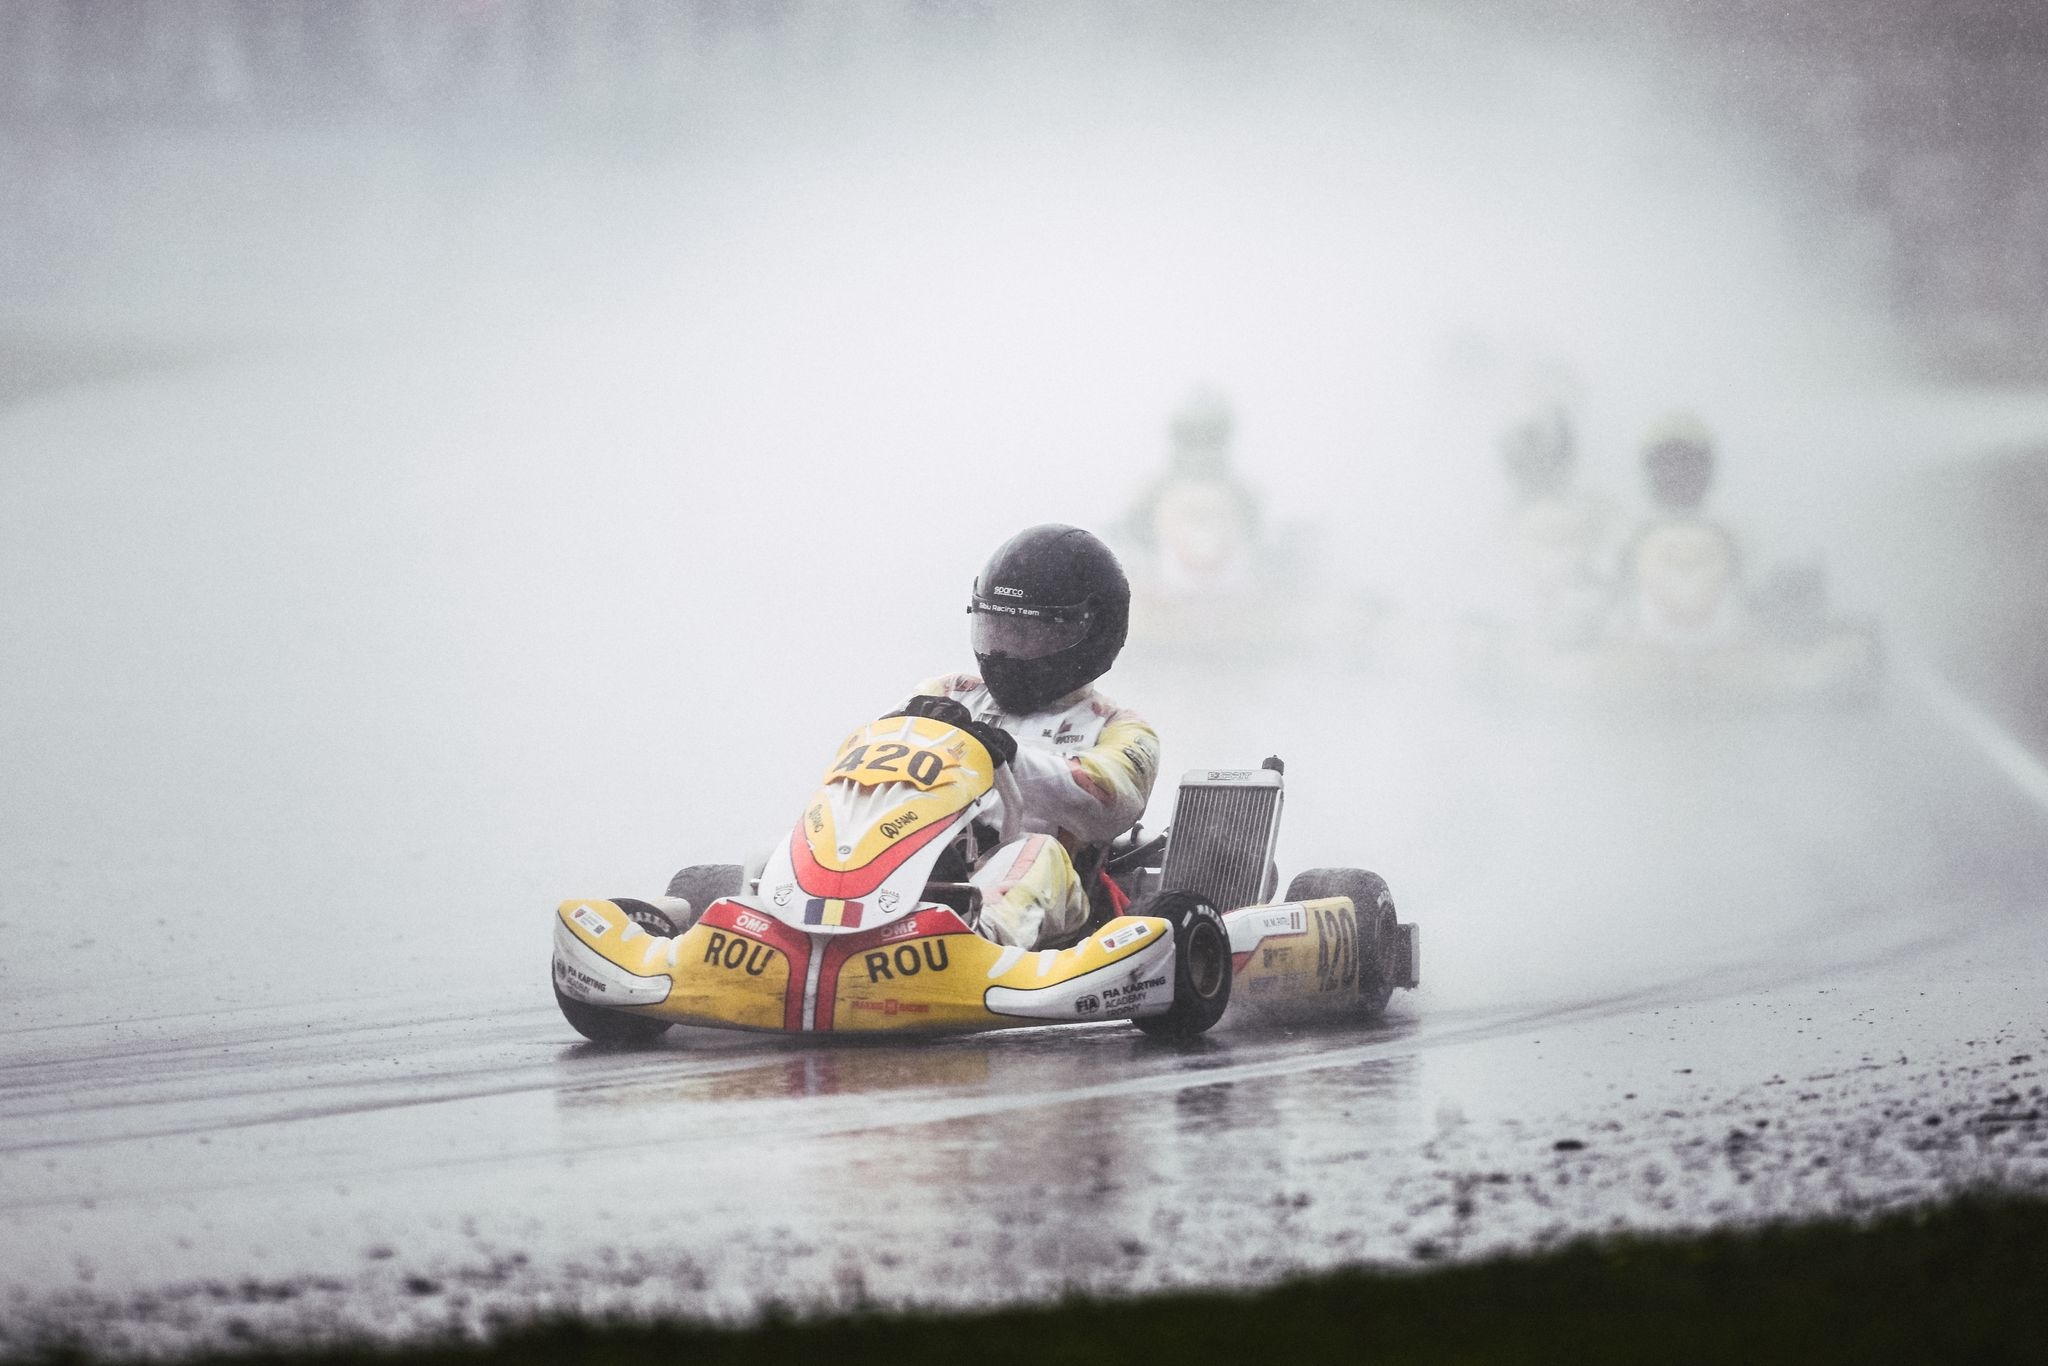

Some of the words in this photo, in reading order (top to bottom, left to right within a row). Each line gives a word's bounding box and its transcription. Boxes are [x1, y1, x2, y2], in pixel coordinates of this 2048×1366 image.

[994, 586, 1023, 597] sparco
[992, 604, 1015, 614] Racing
[1018, 607, 1039, 616] Team
[833, 744, 943, 785] 420
[736, 914, 769, 933] OMP
[880, 920, 917, 937] OMP
[704, 932, 775, 976] ROU
[865, 939, 948, 983] ROU
[1103, 989, 1120, 999] FIA
[1123, 976, 1166, 993] KARTING
